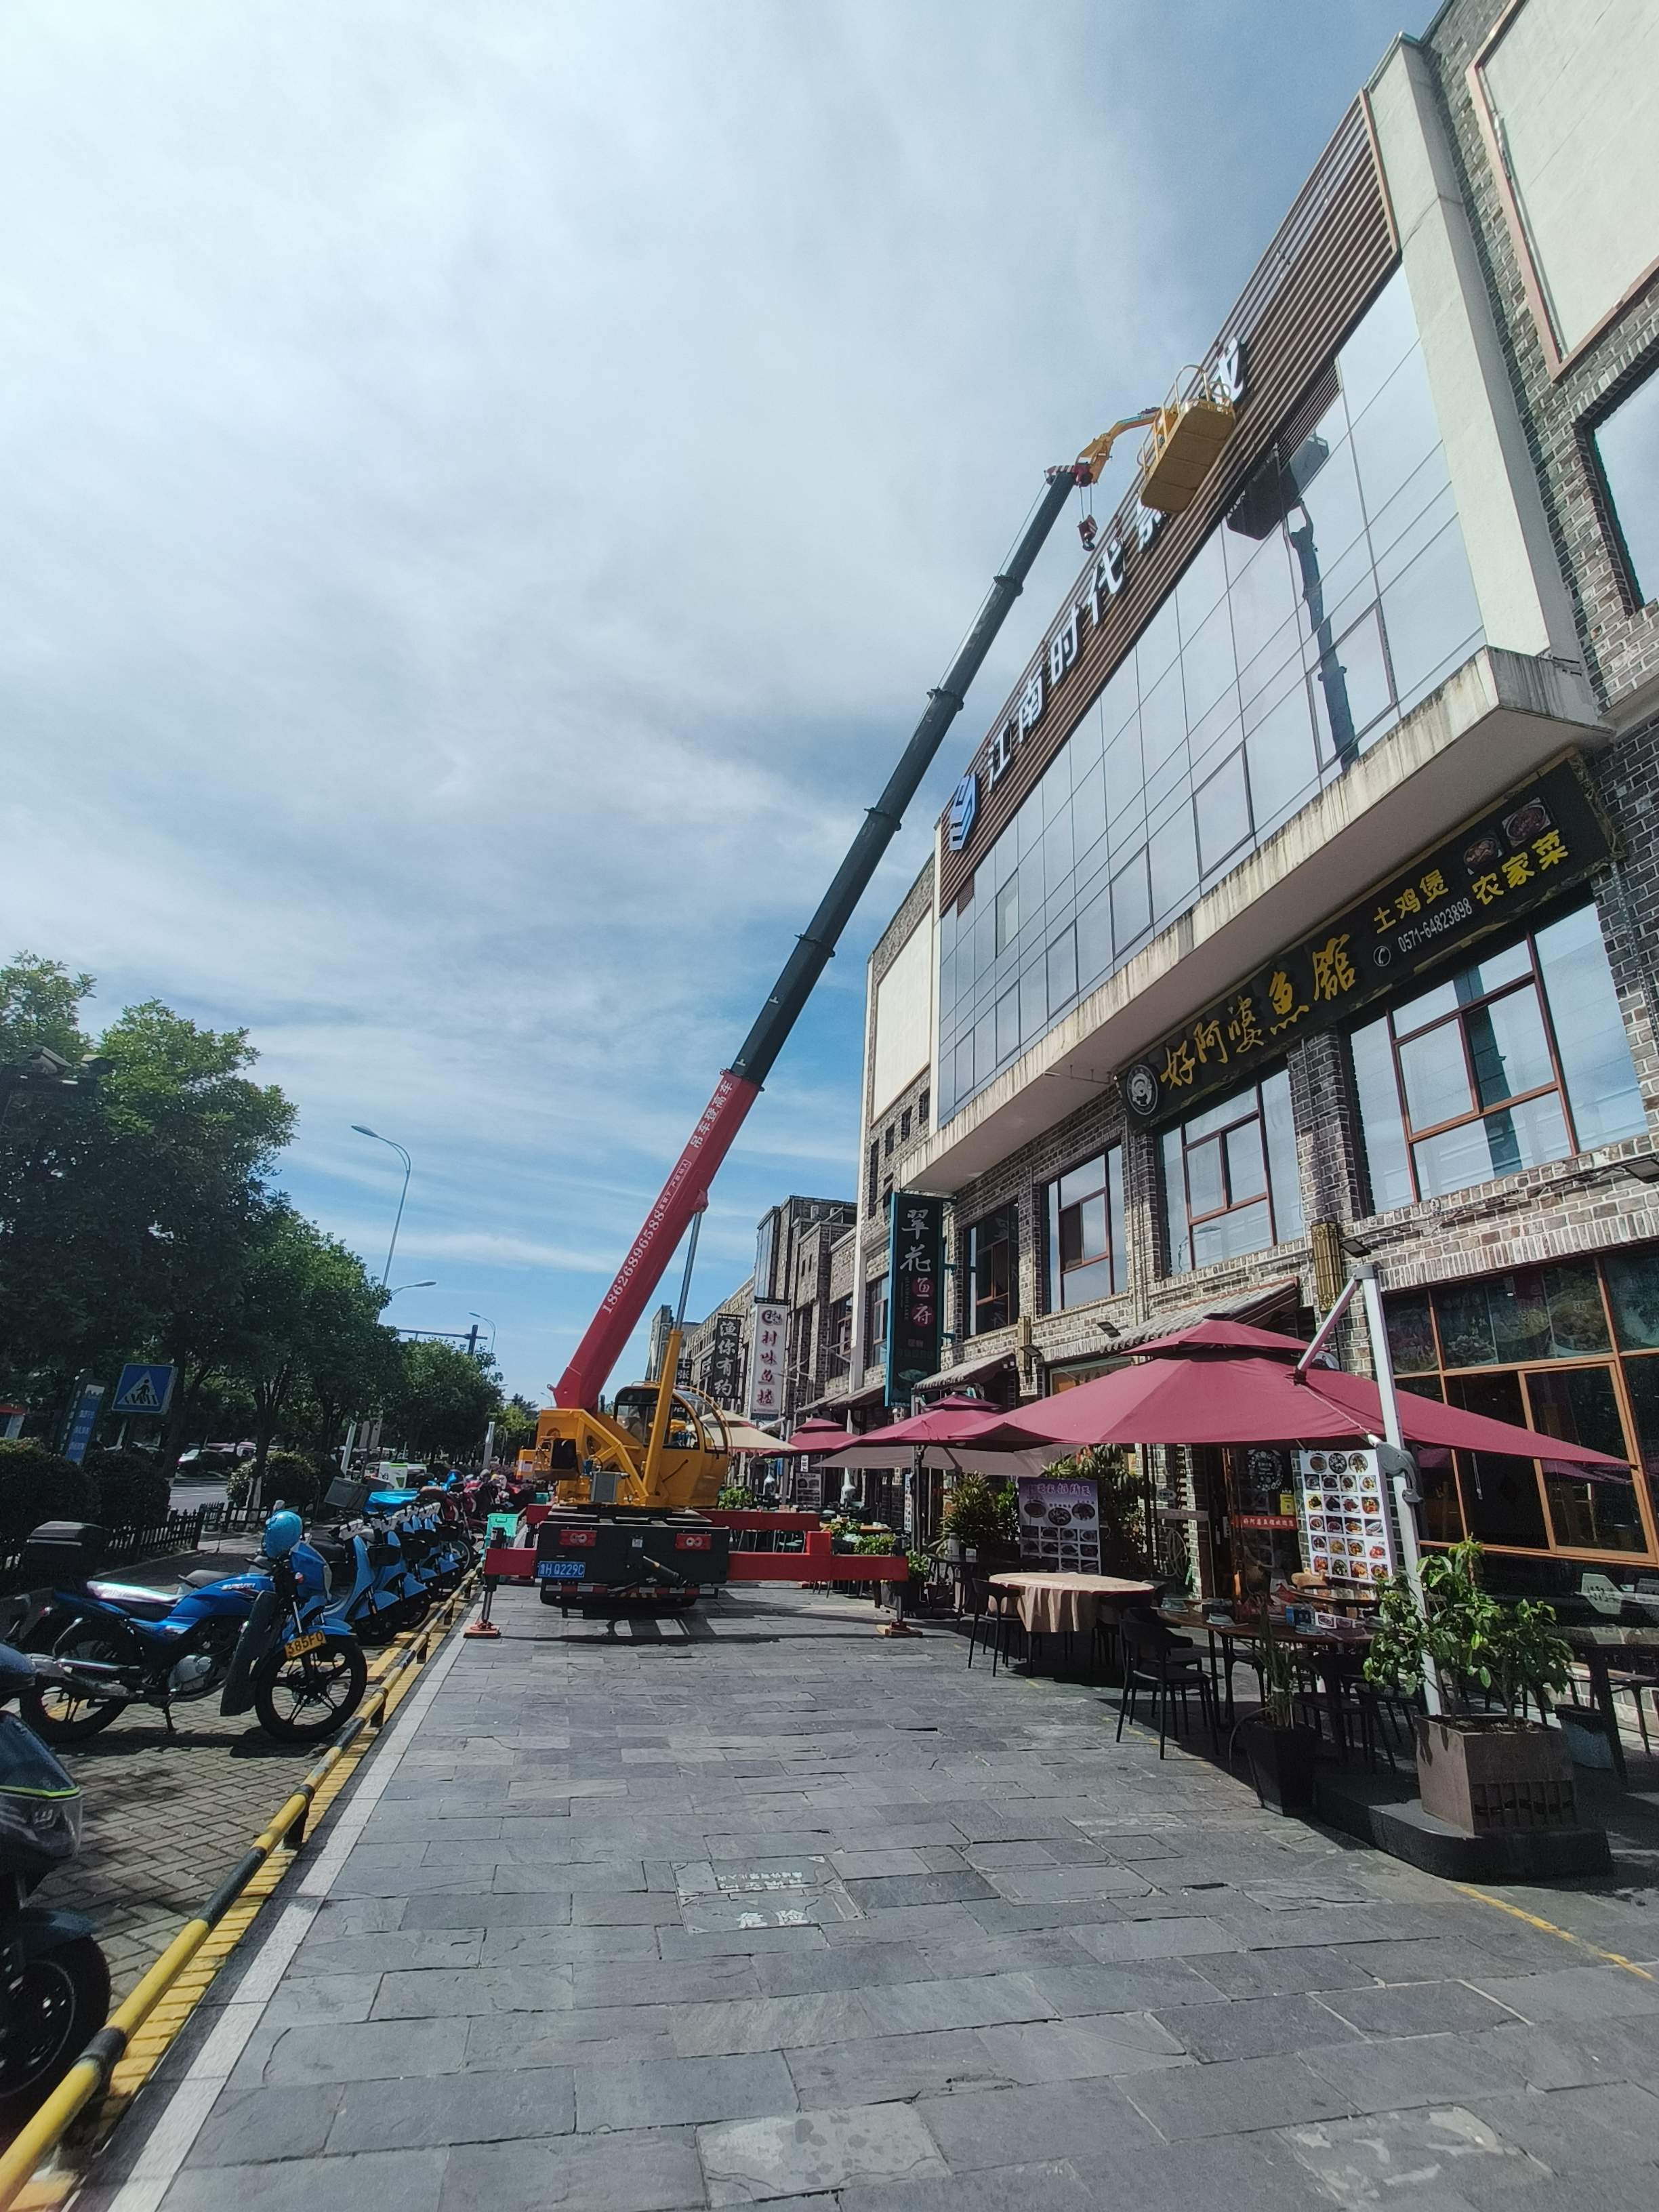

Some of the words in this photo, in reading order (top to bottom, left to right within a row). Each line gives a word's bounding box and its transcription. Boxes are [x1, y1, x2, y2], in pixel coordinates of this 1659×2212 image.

[1373, 868, 1450, 935] 土鸡煲
[1471, 828, 1570, 905] 农家菜
[1398, 897, 1473, 953] 0571-64823898
[689, 1079, 734, 1149] 吊车登高车
[602, 1210, 665, 1315] 18626896588
[714, 1321, 737, 1397] 渔你有约
